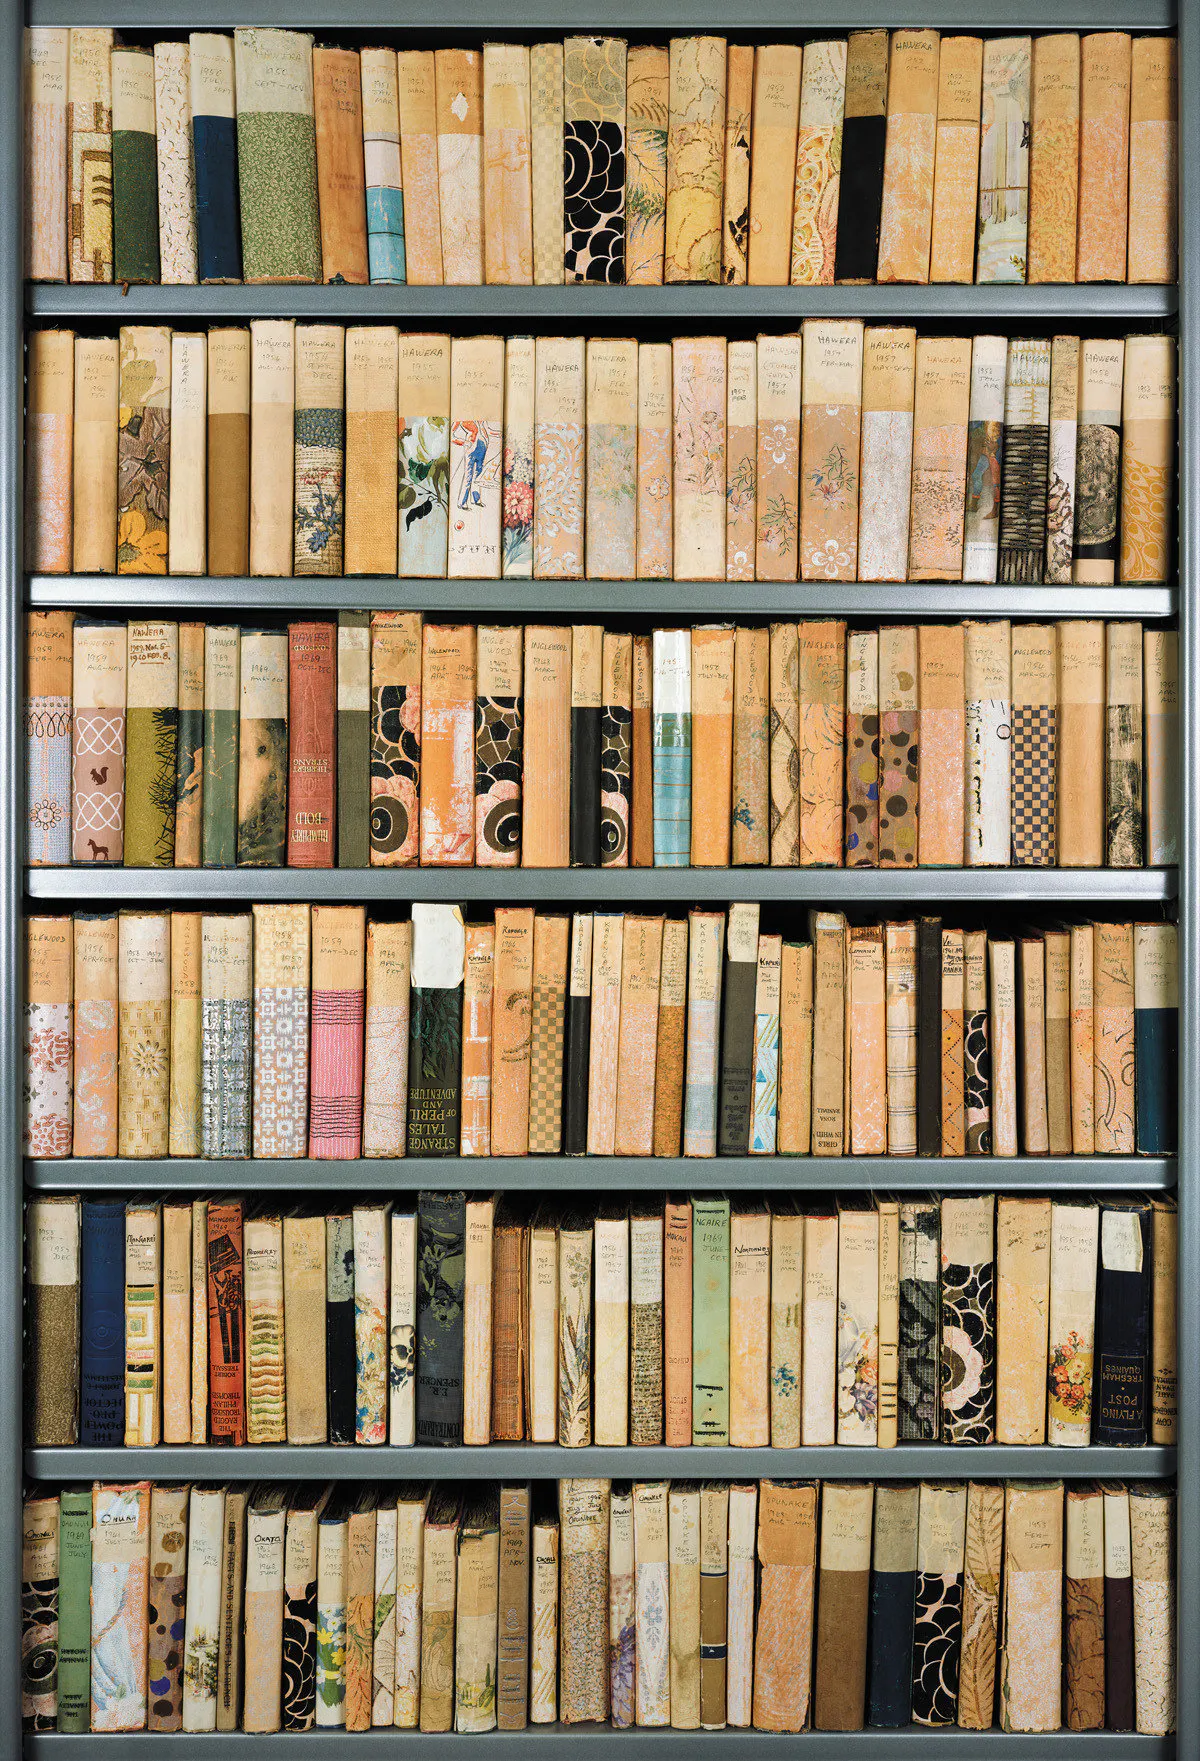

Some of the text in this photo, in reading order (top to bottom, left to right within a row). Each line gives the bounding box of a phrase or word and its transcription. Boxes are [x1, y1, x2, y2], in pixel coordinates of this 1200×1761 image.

[896, 42, 933, 51] HAWERA
[201, 67, 222, 76] 1950
[42, 73, 62, 82] 1950
[767, 83, 786, 92] 1952
[257, 340, 292, 349] HAWERA
[302, 340, 336, 349] HAWERA
[818, 336, 857, 345] HAWERA
[870, 342, 910, 350] HAWERA
[403, 348, 444, 358] HAWERA
[592, 355, 627, 363] HAWERA
[1086, 354, 1119, 363] HAWERA
[546, 364, 580, 373] HAWERA
[26, 631, 65, 639] HAWERA
[132, 628, 164, 637] HAWERA
[291, 633, 330, 643] HAWERA
[531, 643, 568, 652] INGLEWOOD
[86, 653, 108, 662] 1959
[302, 653, 321, 662] 1969
[293, 758, 328, 766] STRANG
[295, 812, 321, 824] BOLD
[290, 830, 328, 842] HUMPHREY
[410, 1088, 456, 1099] ADVENTURE
[422, 1100, 442, 1108] AND
[409, 1109, 445, 1121] PERIL
[408, 1123, 446, 1135] TALES
[407, 1138, 455, 1149] STRANGE
[696, 1219, 728, 1227] NGAIRE
[703, 1233, 723, 1242] 1969
[418, 1376, 460, 1387] SPENCER
[1102, 1373, 1143, 1383] TRESHAM
[429, 1387, 448, 1396] E.R.
[1108, 1394, 1138, 1406] POST
[1102, 1407, 1143, 1419] A FLYING
[1155, 1418, 1172, 1426] COW
[91, 1433, 112, 1442] THE
[766, 1497, 809, 1508] OPUNAKE
[66, 1531, 85, 1540] 1969
[255, 1534, 282, 1544] OKATO
[69, 1550, 88, 1559] JULY
[227, 1550, 235, 1579] FACTS
[226, 1583, 234, 1601] AND
[225, 1603, 233, 1656] SENTENCES
[61, 1648, 86, 1656] MORRIS
[224, 1660, 231, 1668] IN
[223, 1671, 231, 1707] FRENCH
